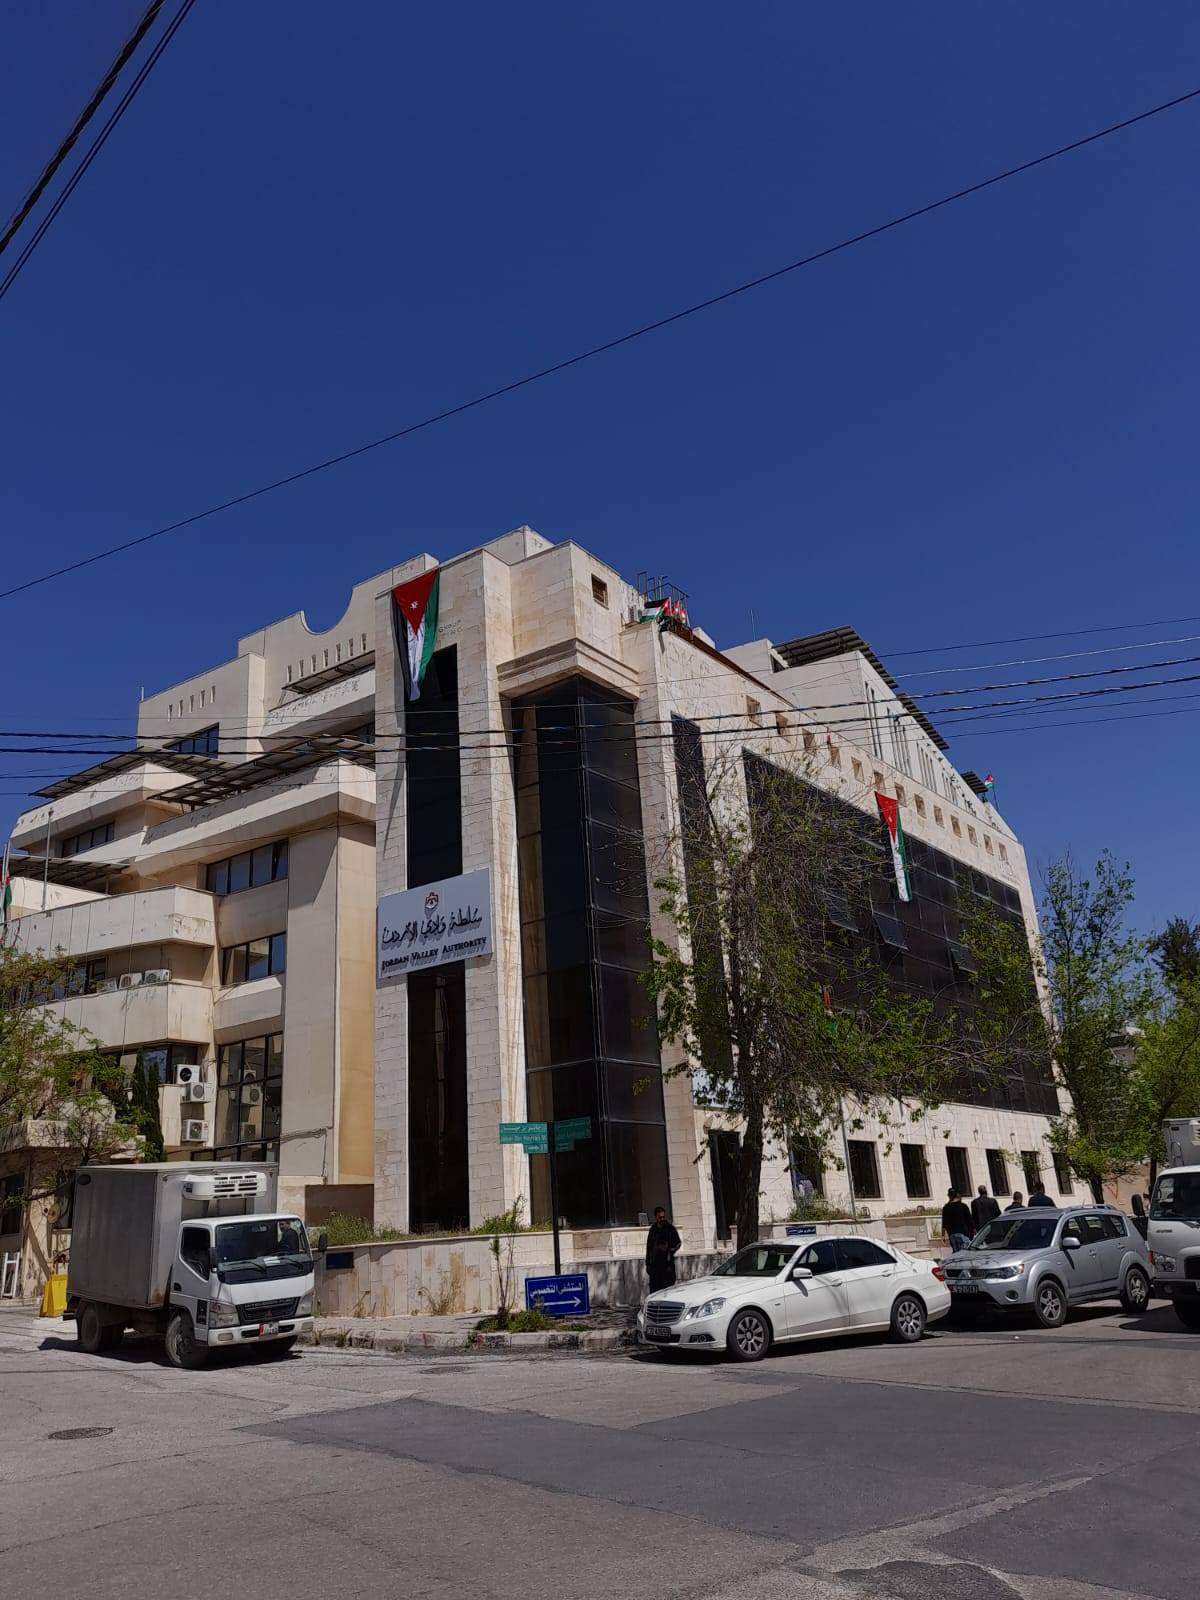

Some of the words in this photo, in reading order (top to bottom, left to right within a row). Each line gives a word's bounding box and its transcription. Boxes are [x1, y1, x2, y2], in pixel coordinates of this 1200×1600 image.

[382, 955, 410, 971] JORDAN
[411, 948, 439, 961] VALLEY
[442, 936, 487, 953] AUTHORITY
